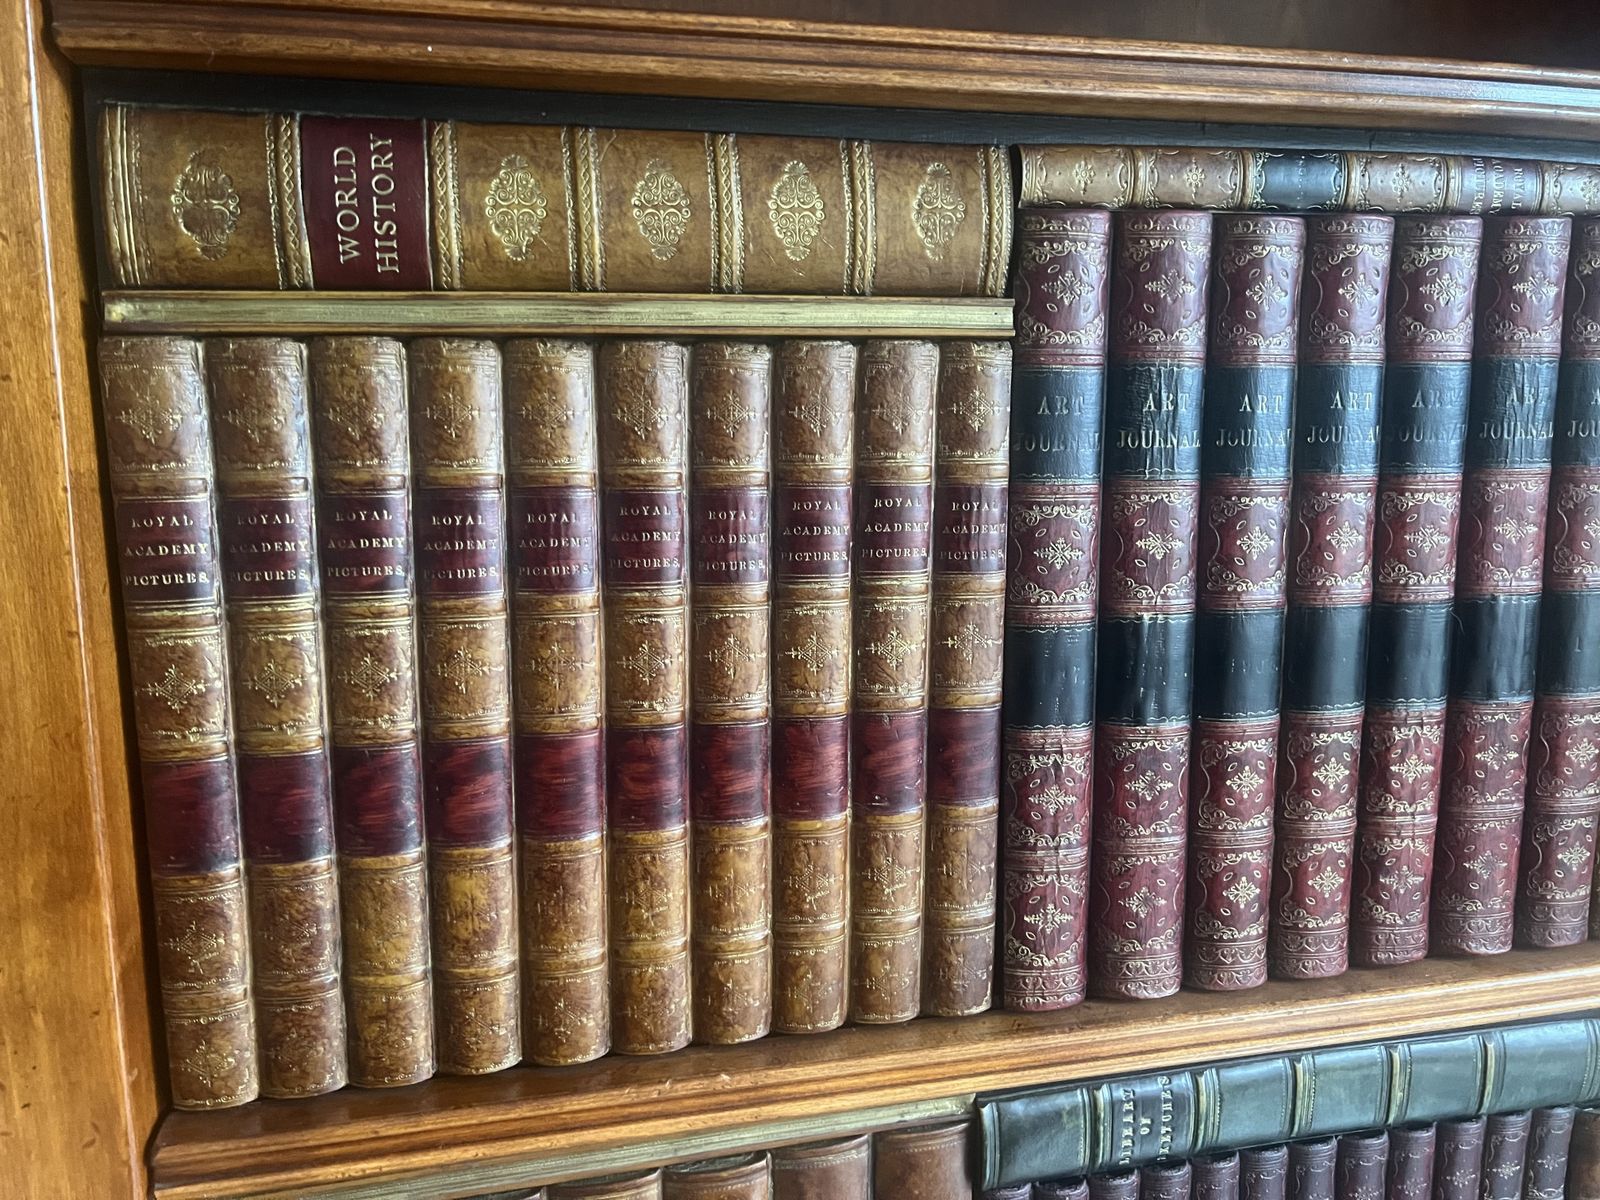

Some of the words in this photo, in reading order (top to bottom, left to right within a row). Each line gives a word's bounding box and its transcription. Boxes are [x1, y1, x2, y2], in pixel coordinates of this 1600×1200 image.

[1511, 167, 1525, 209] ROYAL
[333, 146, 361, 264] WORLD
[370, 133, 400, 273] HISTORY
[1142, 392, 1190, 412] ART
[1239, 393, 1283, 414] ART
[1330, 390, 1373, 410] ART
[1116, 429, 1201, 449] JOURNAL
[792, 500, 841, 511] ROYAL
[874, 497, 922, 508] ROYAL
[951, 501, 999, 511] ROYAL
[336, 509, 393, 522] ROYAL
[619, 505, 671, 516] ROYAL
[708, 509, 757, 520] ROYAL
[132, 514, 194, 528] ROYAL
[237, 512, 295, 525] ROYAL
[432, 514, 487, 526] ROYAL
[527, 511, 579, 523] ROYAL
[783, 525, 850, 536] ACADEMY
[864, 521, 929, 532] ACADEMY
[942, 523, 1006, 534] ACADEMY
[327, 536, 405, 549] ACADEMY
[519, 536, 591, 548] ACADEMY
[610, 531, 681, 542] ACADEMY
[700, 532, 766, 544] ACADEMY
[125, 542, 209, 556] ACADEMY
[423, 538, 497, 550] ACADEMY
[1118, 1088, 1135, 1165] LIBRARY
[1140, 1117, 1151, 1135] OF
